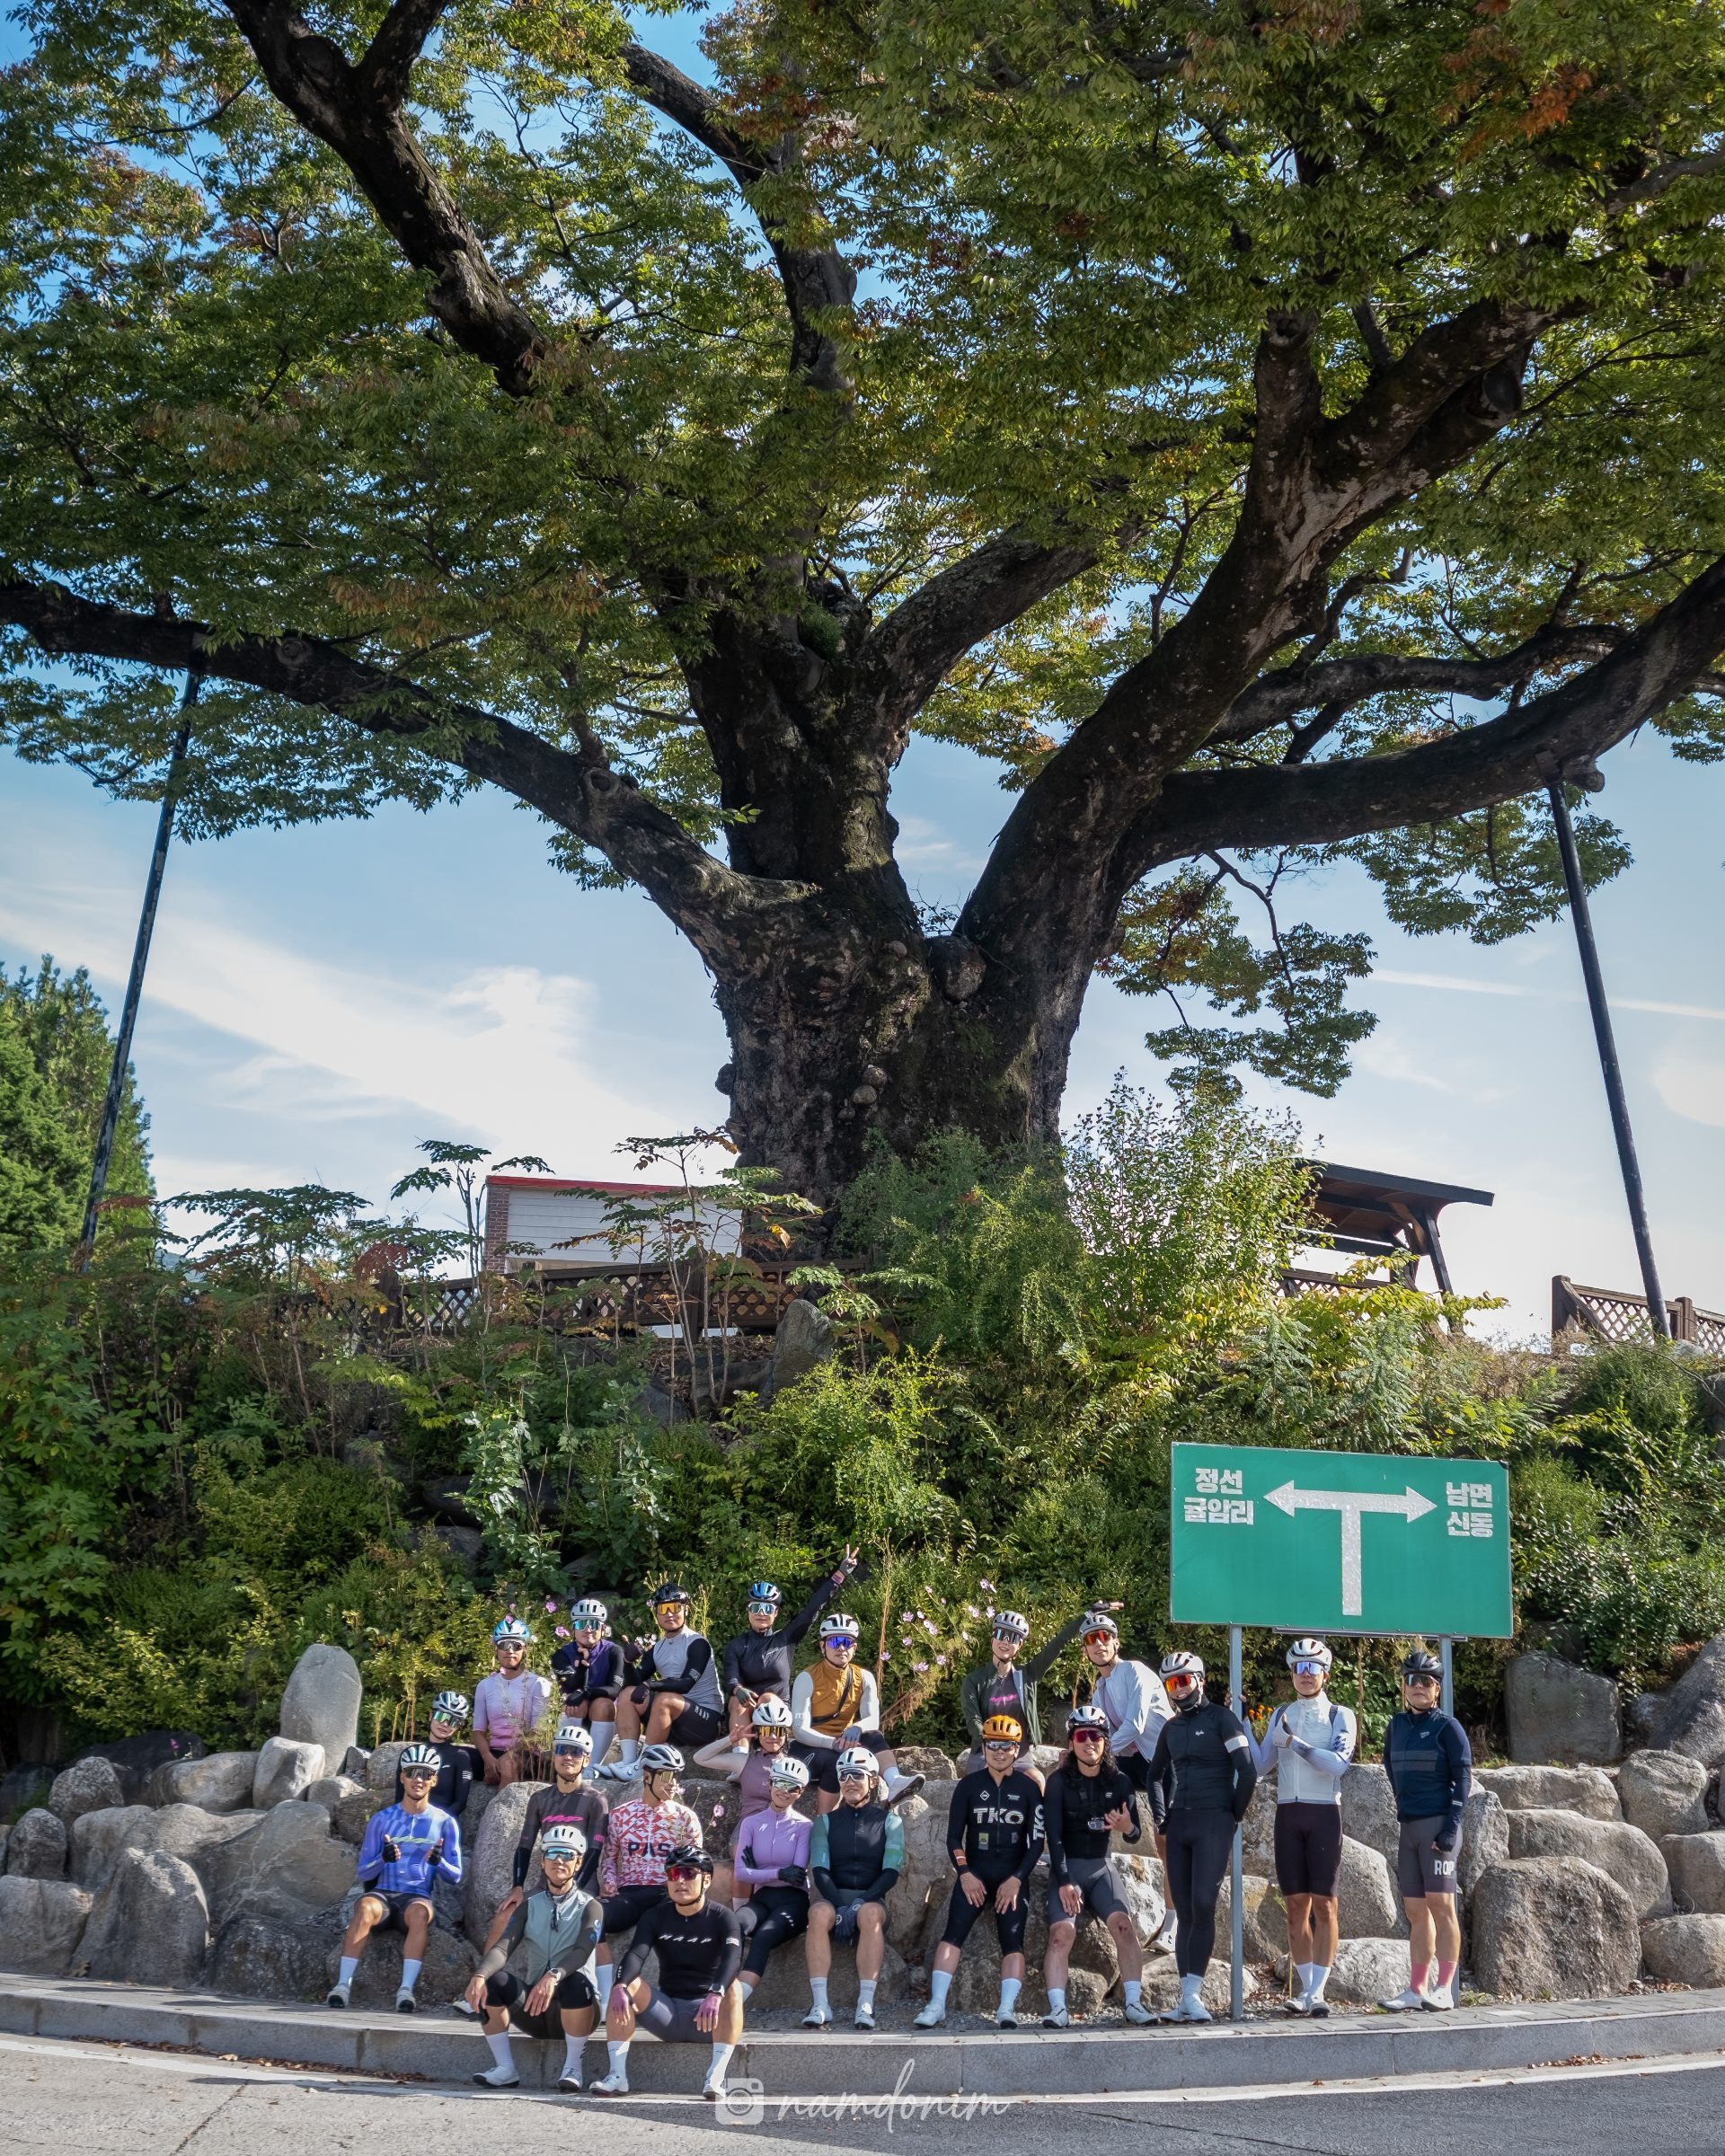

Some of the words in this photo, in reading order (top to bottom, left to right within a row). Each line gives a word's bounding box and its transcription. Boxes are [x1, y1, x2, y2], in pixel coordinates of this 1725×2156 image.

[1195, 1468, 1243, 1495] 정선
[1446, 1481, 1493, 1508] 남면
[1184, 1497, 1254, 1525] 귤암리
[1446, 1511, 1494, 1538] 신동
[973, 1807, 1024, 1825] TKO
